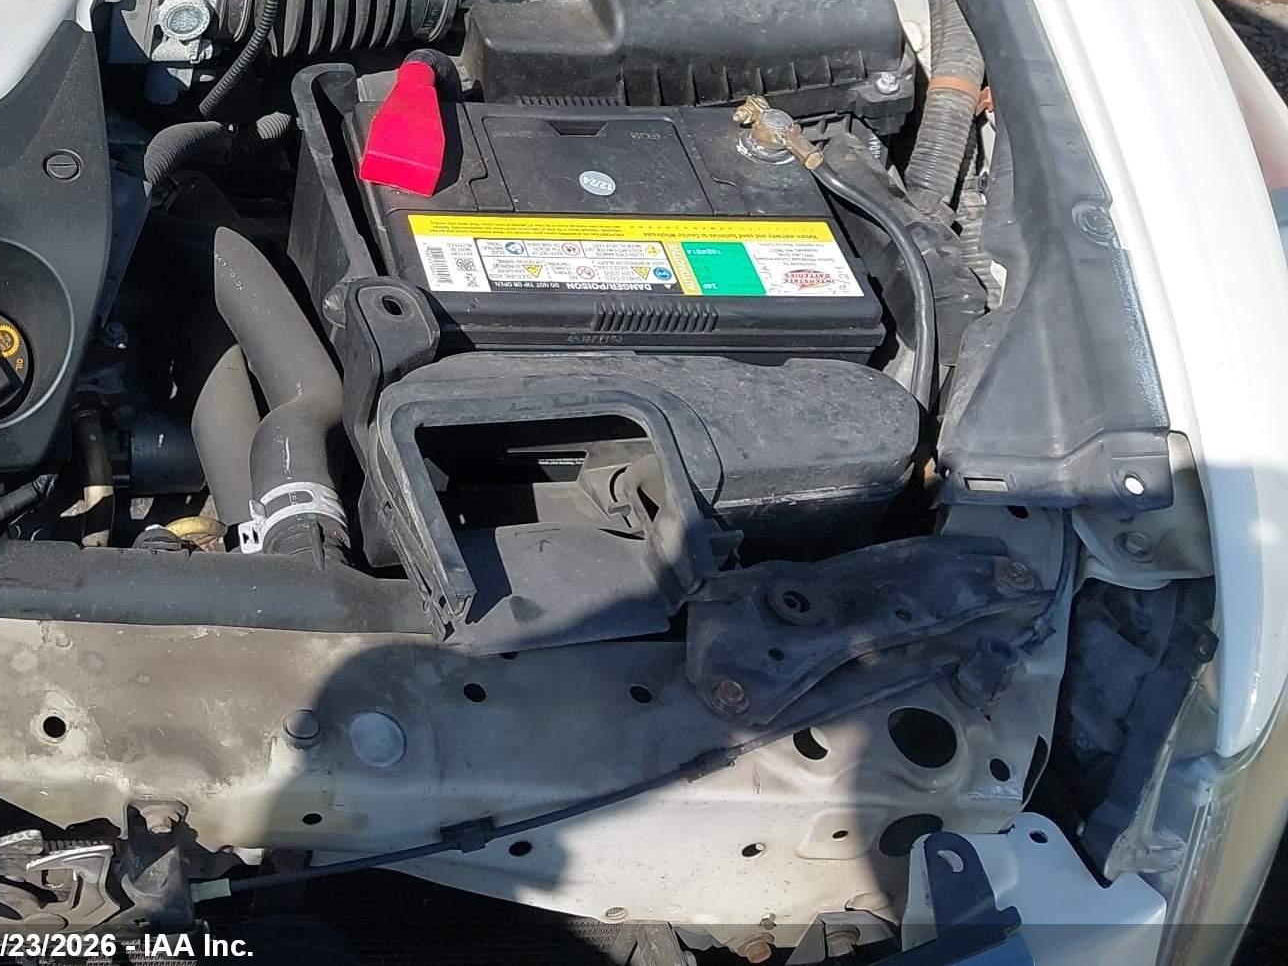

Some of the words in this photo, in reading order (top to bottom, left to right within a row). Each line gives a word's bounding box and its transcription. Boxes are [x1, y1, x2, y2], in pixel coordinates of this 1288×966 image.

[583, 176, 613, 191] 12/24
[565, 282, 652, 291] DANGER/POISON
[15, 358, 24, 370] OIL
